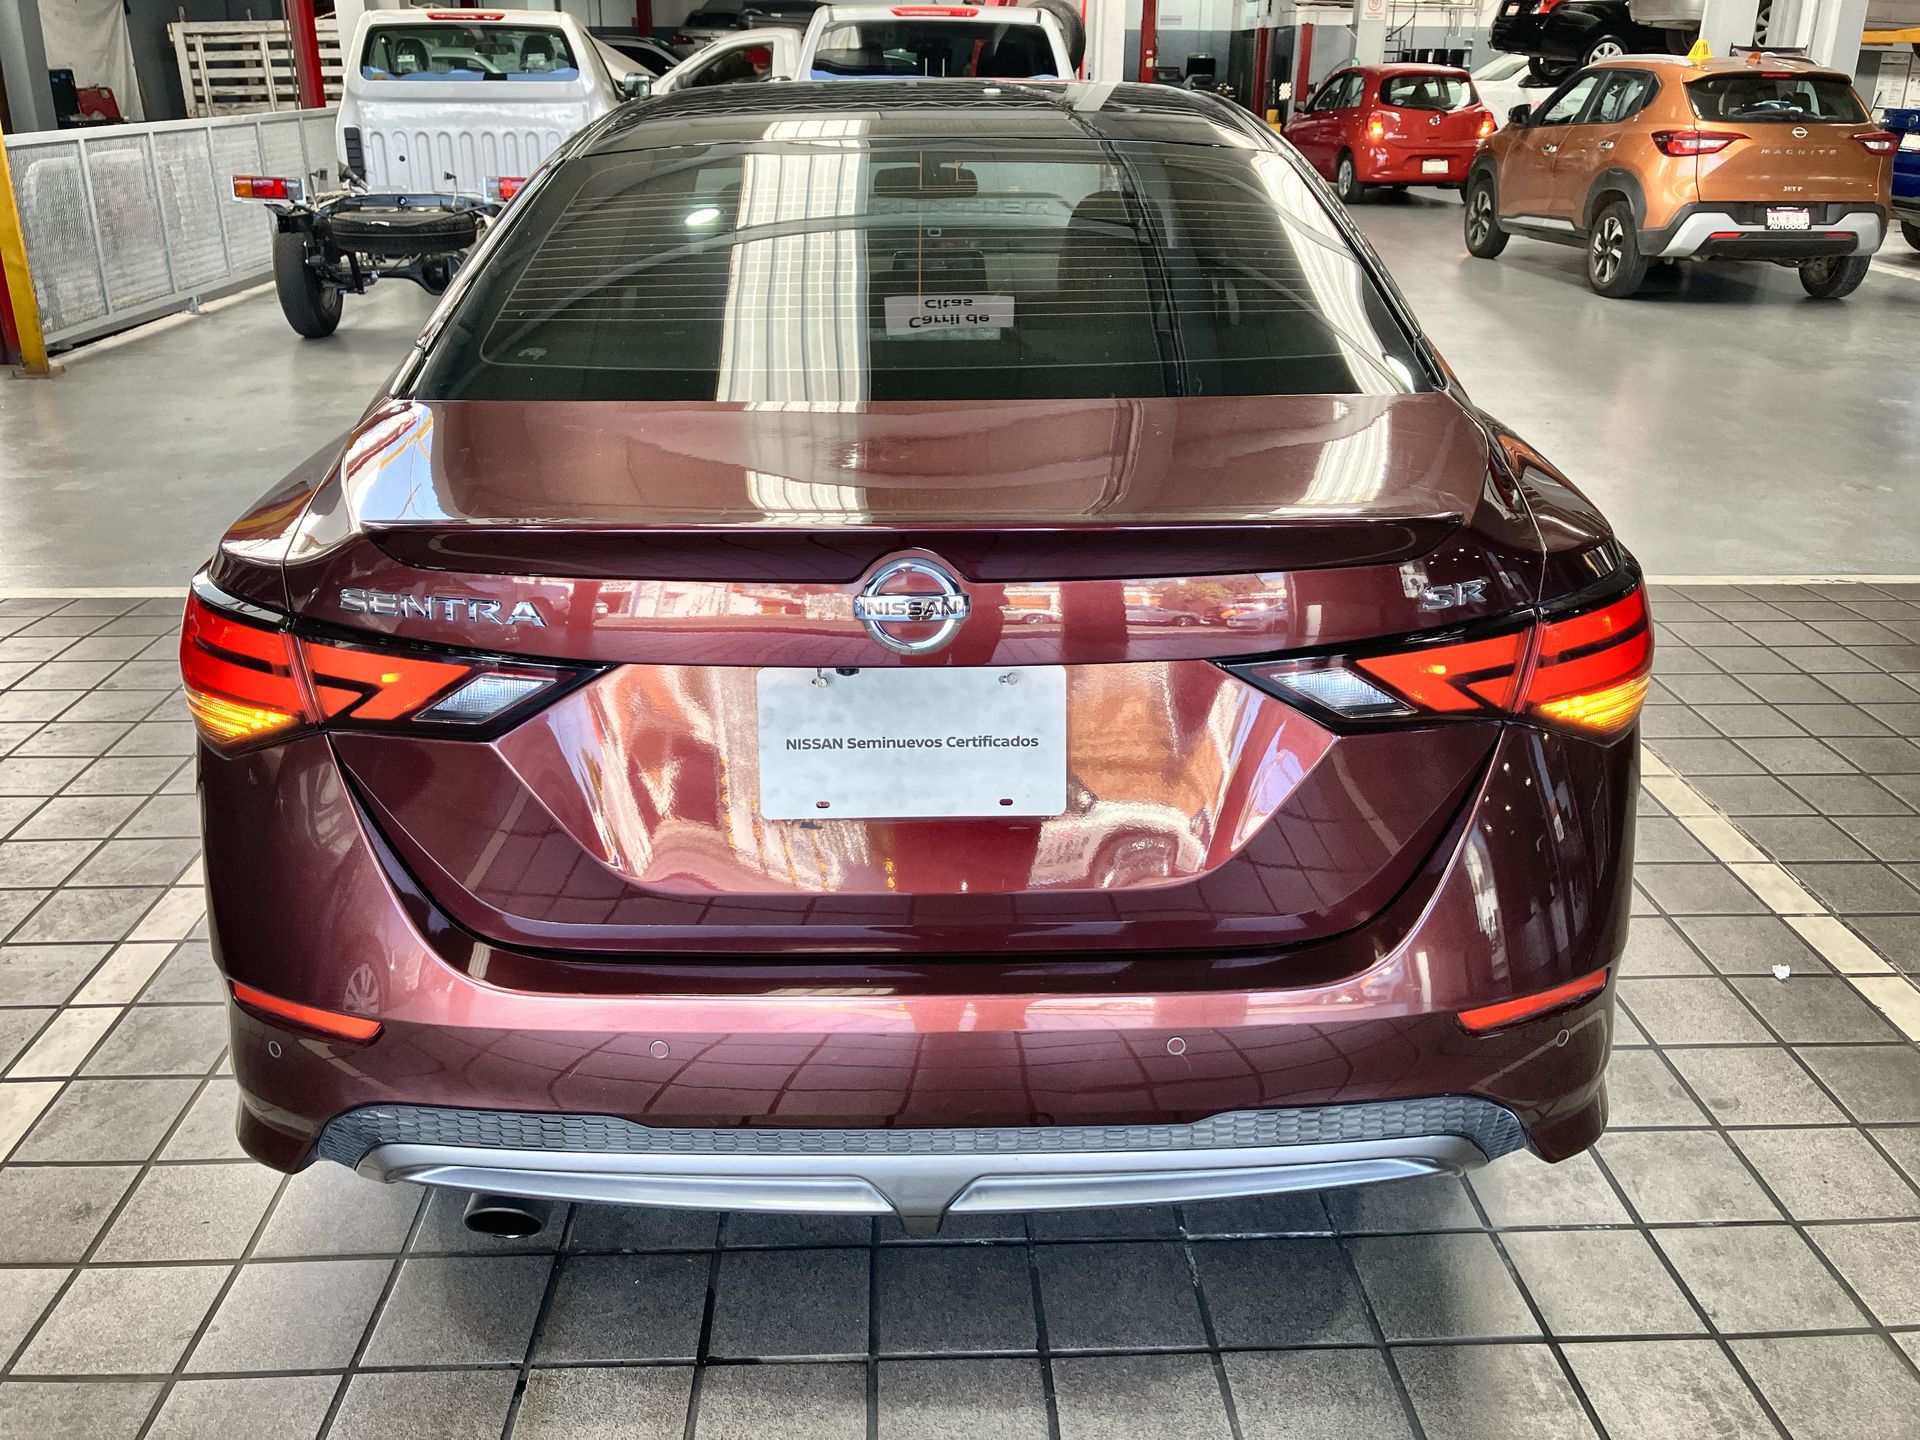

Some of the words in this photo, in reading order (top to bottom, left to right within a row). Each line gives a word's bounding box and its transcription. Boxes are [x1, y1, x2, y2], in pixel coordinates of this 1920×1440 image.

[1760, 148, 1837, 156] MAGNITE
[1423, 579, 1488, 610] SR
[339, 588, 548, 628] SENTRA
[865, 601, 959, 616] NISSAN
[786, 737, 844, 750] NISSAN
[847, 736, 943, 750] Seminuevos
[946, 734, 1039, 749] Certificados
